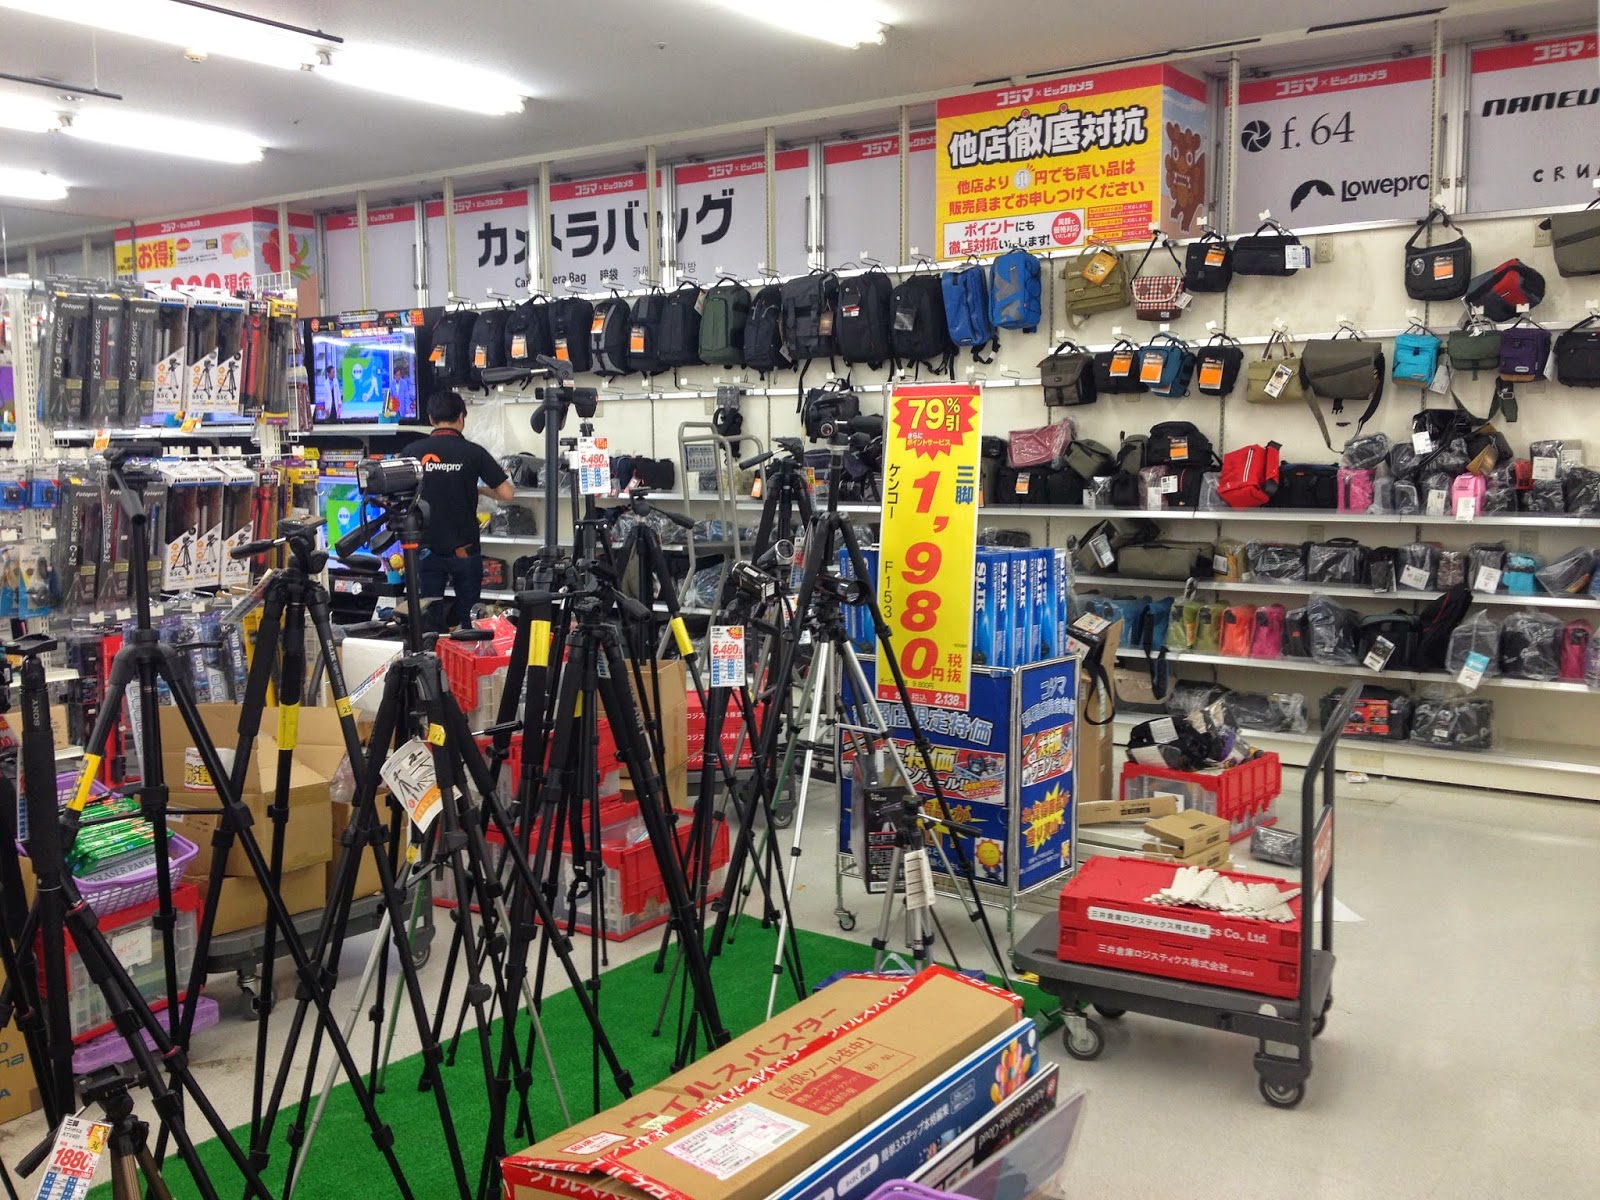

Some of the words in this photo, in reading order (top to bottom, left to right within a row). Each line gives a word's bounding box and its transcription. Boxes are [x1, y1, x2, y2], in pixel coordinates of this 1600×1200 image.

[949, 105, 1148, 168] 他店徹底対抗
[1311, 111, 1355, 145] 64
[1341, 173, 1430, 201] Lowepro
[1532, 164, 1599, 183] CRU
[965, 220, 1035, 237] ポイントにも
[569, 272, 586, 285] Bag
[425, 462, 461, 472] Lowepro
[955, 465, 974, 505] 三脚
[947, 653, 961, 683] 税抜
[32, 699, 40, 727] SONY
